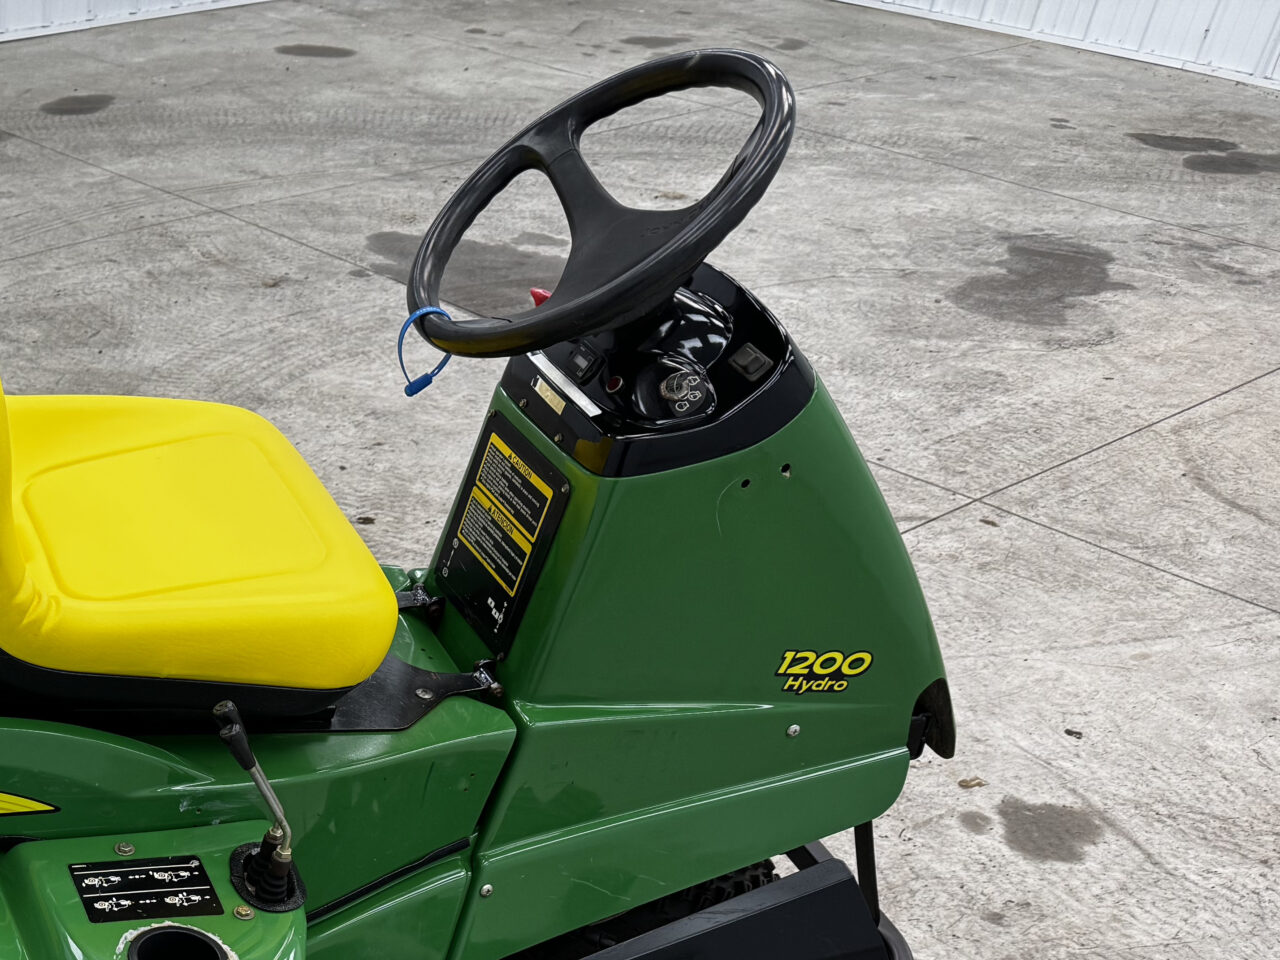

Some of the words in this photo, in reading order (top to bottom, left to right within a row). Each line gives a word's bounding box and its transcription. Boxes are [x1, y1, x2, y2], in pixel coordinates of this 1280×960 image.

[513, 454, 533, 479] CAUTION
[776, 650, 873, 676] 1200
[783, 676, 848, 694] Hydro
